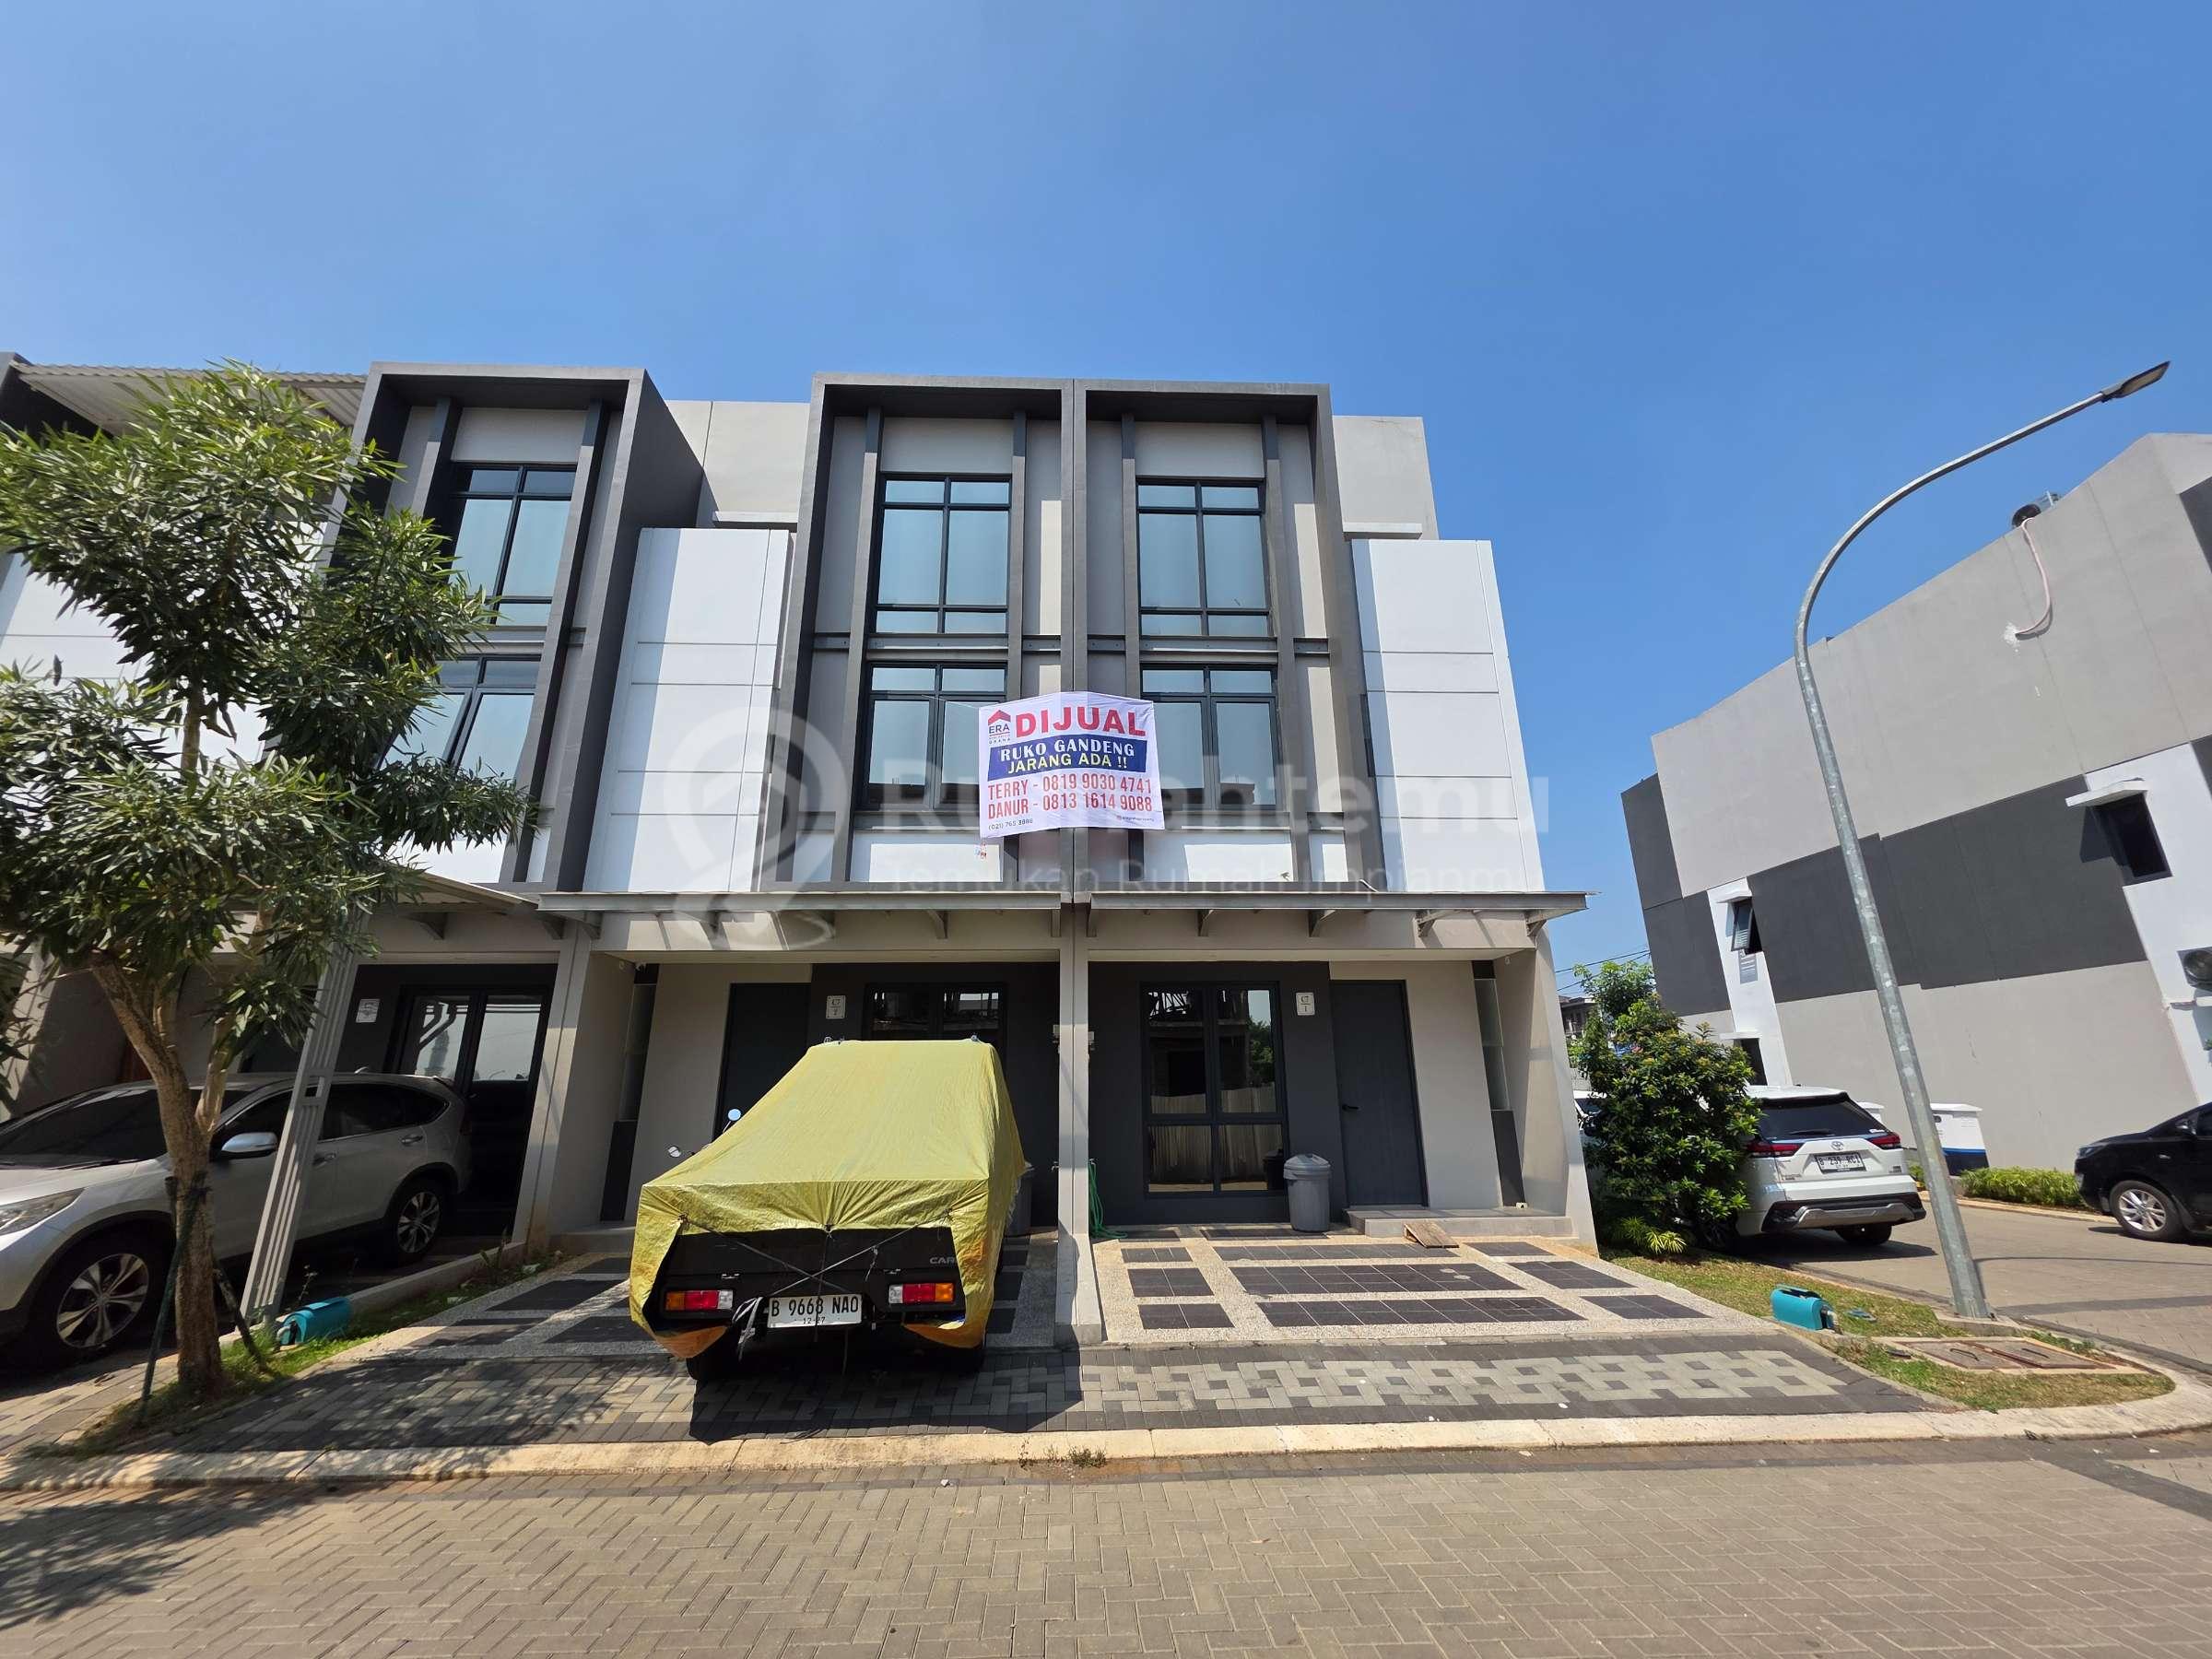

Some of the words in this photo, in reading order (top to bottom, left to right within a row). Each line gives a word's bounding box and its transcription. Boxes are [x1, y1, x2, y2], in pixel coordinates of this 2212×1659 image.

[988, 723, 1010, 735] ERA
[1016, 706, 1146, 737] DIJUAL
[1000, 742, 1047, 762] RUKO
[1053, 739, 1135, 757] GANDENG
[1008, 753, 1072, 774] JARANG
[1078, 753, 1112, 767] ADA
[1117, 756, 1128, 769] !!
[988, 779, 1029, 801] TERRY
[1042, 773, 1077, 792] 0819
[1082, 773, 1115, 791] 9030
[1120, 777, 1152, 794] 4741
[988, 798, 1029, 819] DANUR
[1042, 792, 1077, 811] 0813
[1083, 793, 1115, 809] 1614
[1120, 795, 1153, 812] 9088
[988, 822, 1004, 830] (021)
[771, 1300, 780, 1317] B
[788, 1297, 824, 1316] 9668
[831, 1296, 859, 1313] NAO
